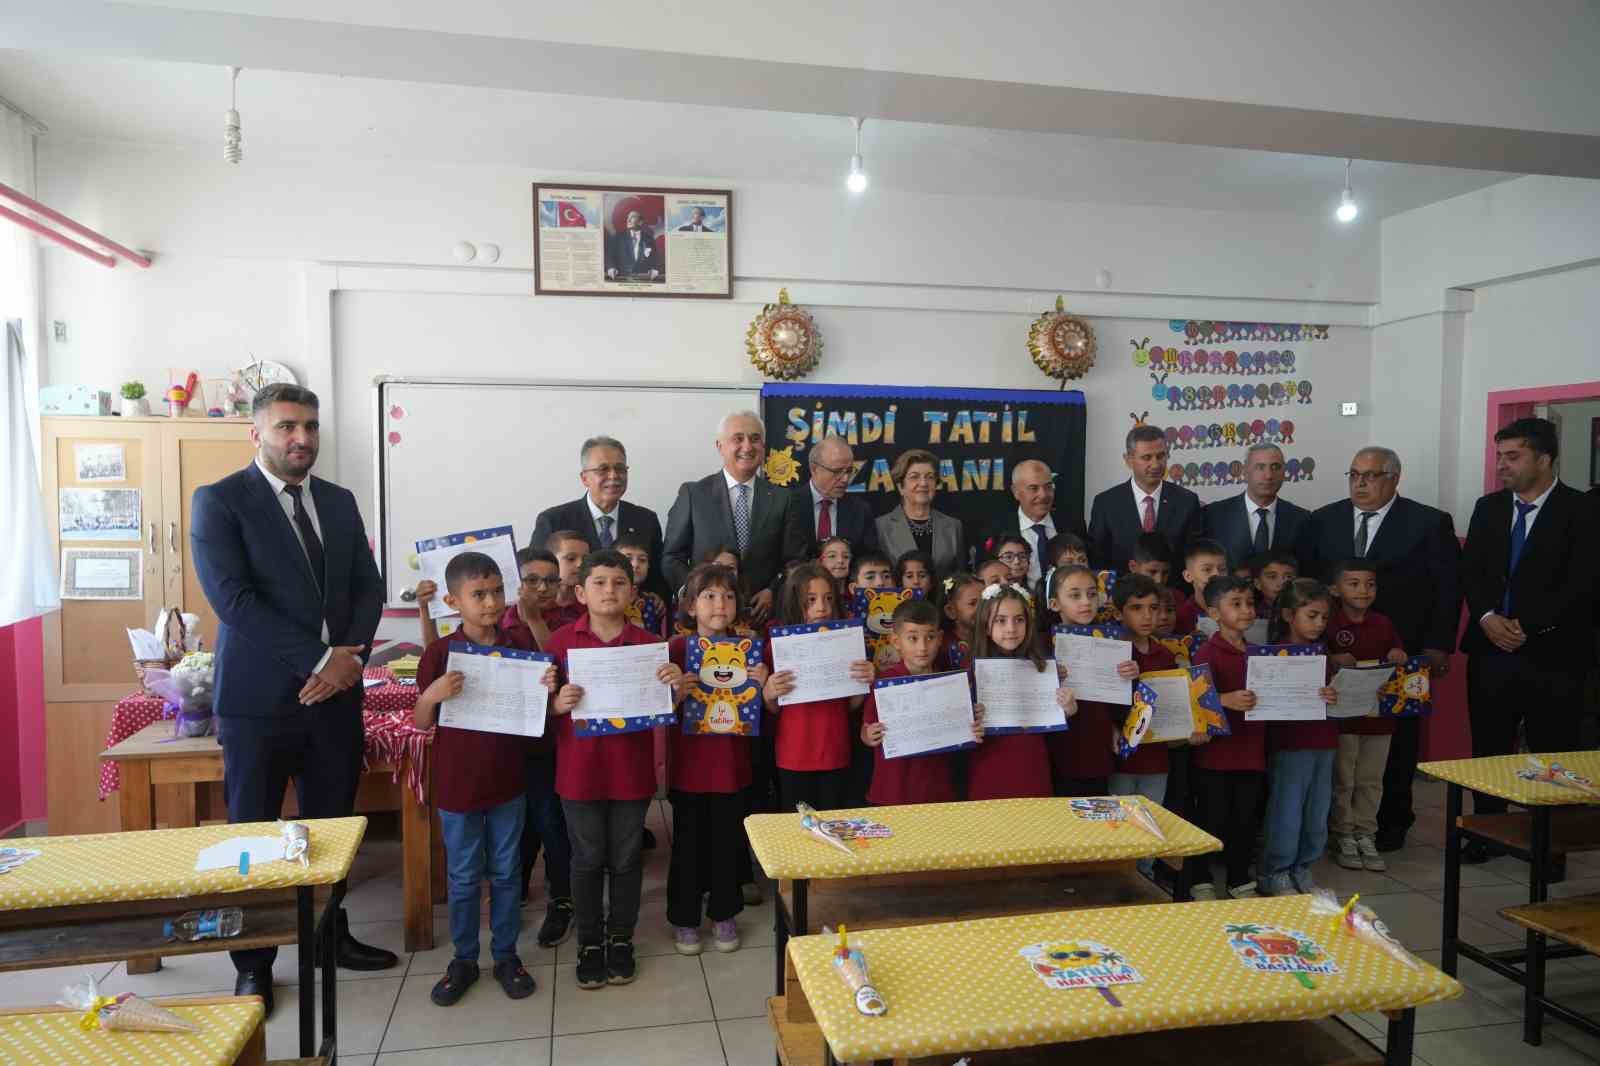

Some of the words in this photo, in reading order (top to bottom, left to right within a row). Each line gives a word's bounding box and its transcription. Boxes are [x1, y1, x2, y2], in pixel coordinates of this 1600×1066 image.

[785, 401, 898, 451] ŞİMDİ
[923, 404, 1037, 444] TATİL
[846, 457, 1004, 492] ZAANI
